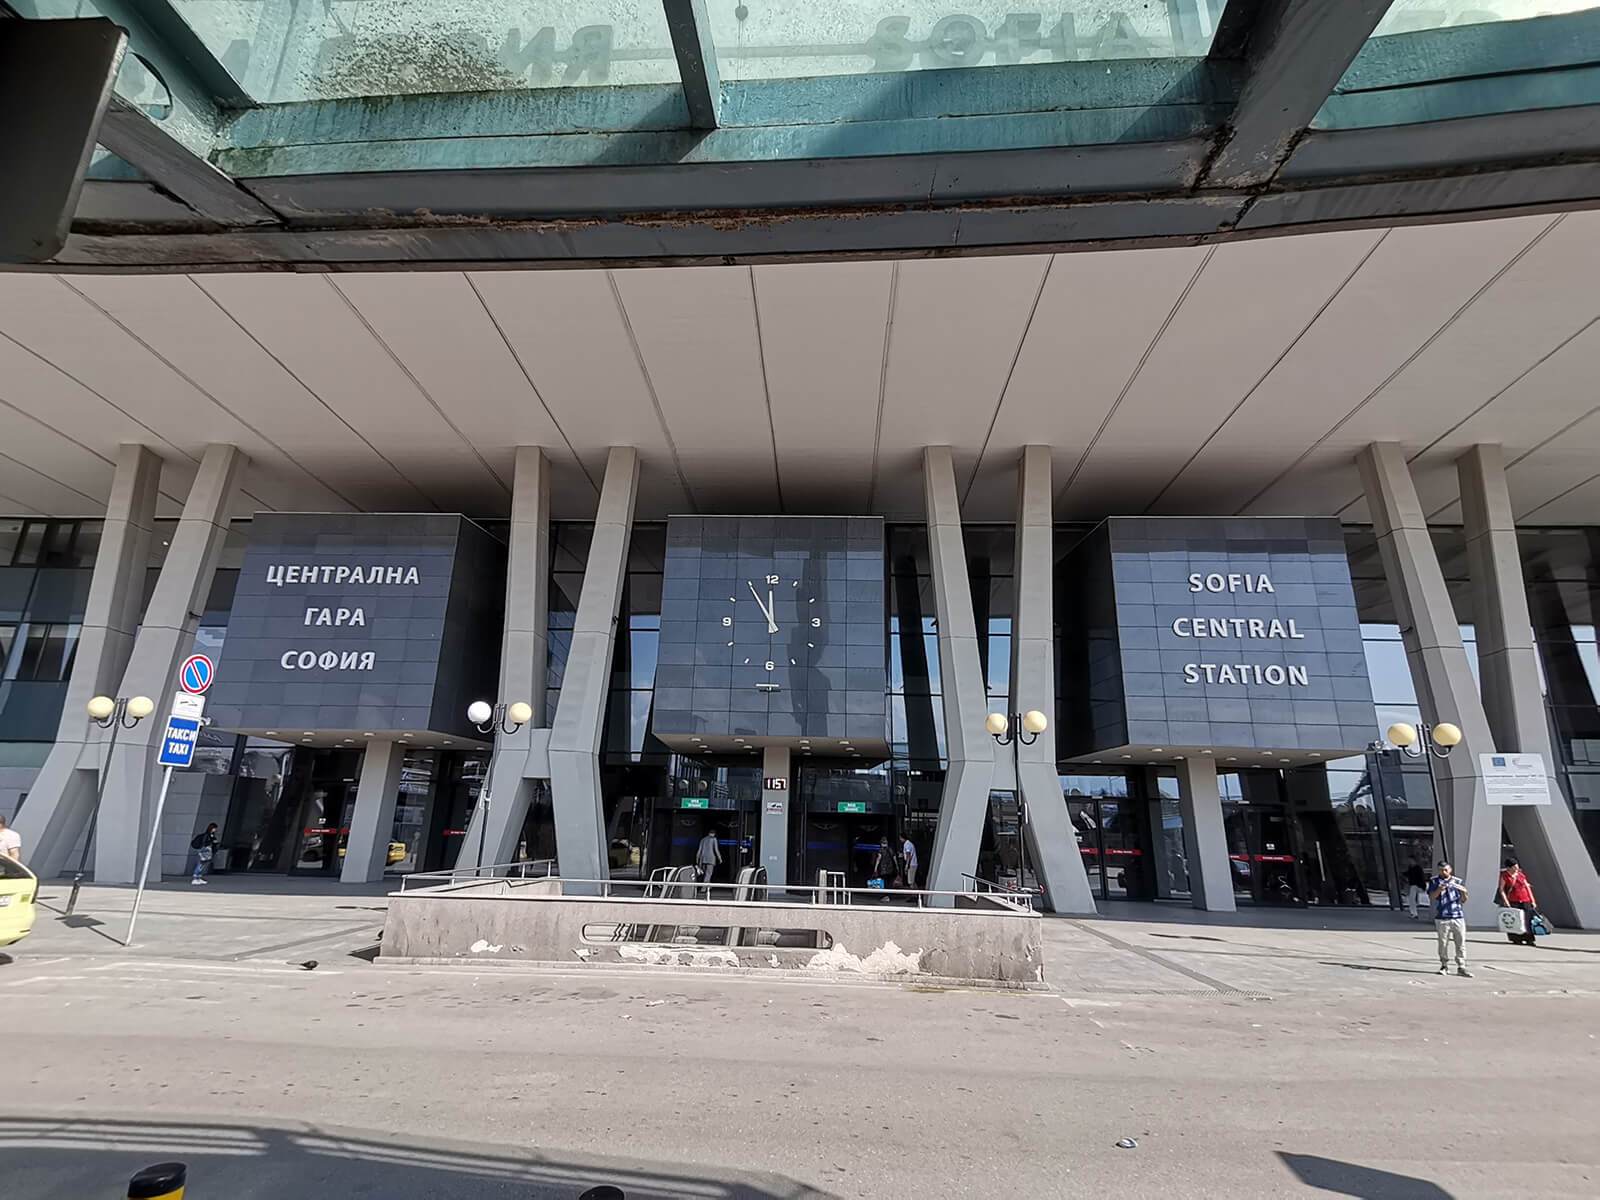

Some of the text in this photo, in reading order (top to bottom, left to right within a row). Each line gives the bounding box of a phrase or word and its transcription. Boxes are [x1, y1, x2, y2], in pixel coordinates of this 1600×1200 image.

[266, 565, 420, 587] ЦЕНТРАЛНА
[765, 575, 780, 585] 12
[1188, 573, 1275, 593] SOFIA
[304, 607, 366, 627] ГАРА
[722, 617, 732, 627] 9
[811, 617, 821, 628] 3
[1172, 617, 1305, 639] CENTRAL
[281, 650, 376, 671] СОФИЯ
[765, 661, 775, 671] 6
[1184, 663, 1309, 686] STATION
[168, 727, 196, 741] ТАКСИ
[169, 743, 189, 755] TAXI
